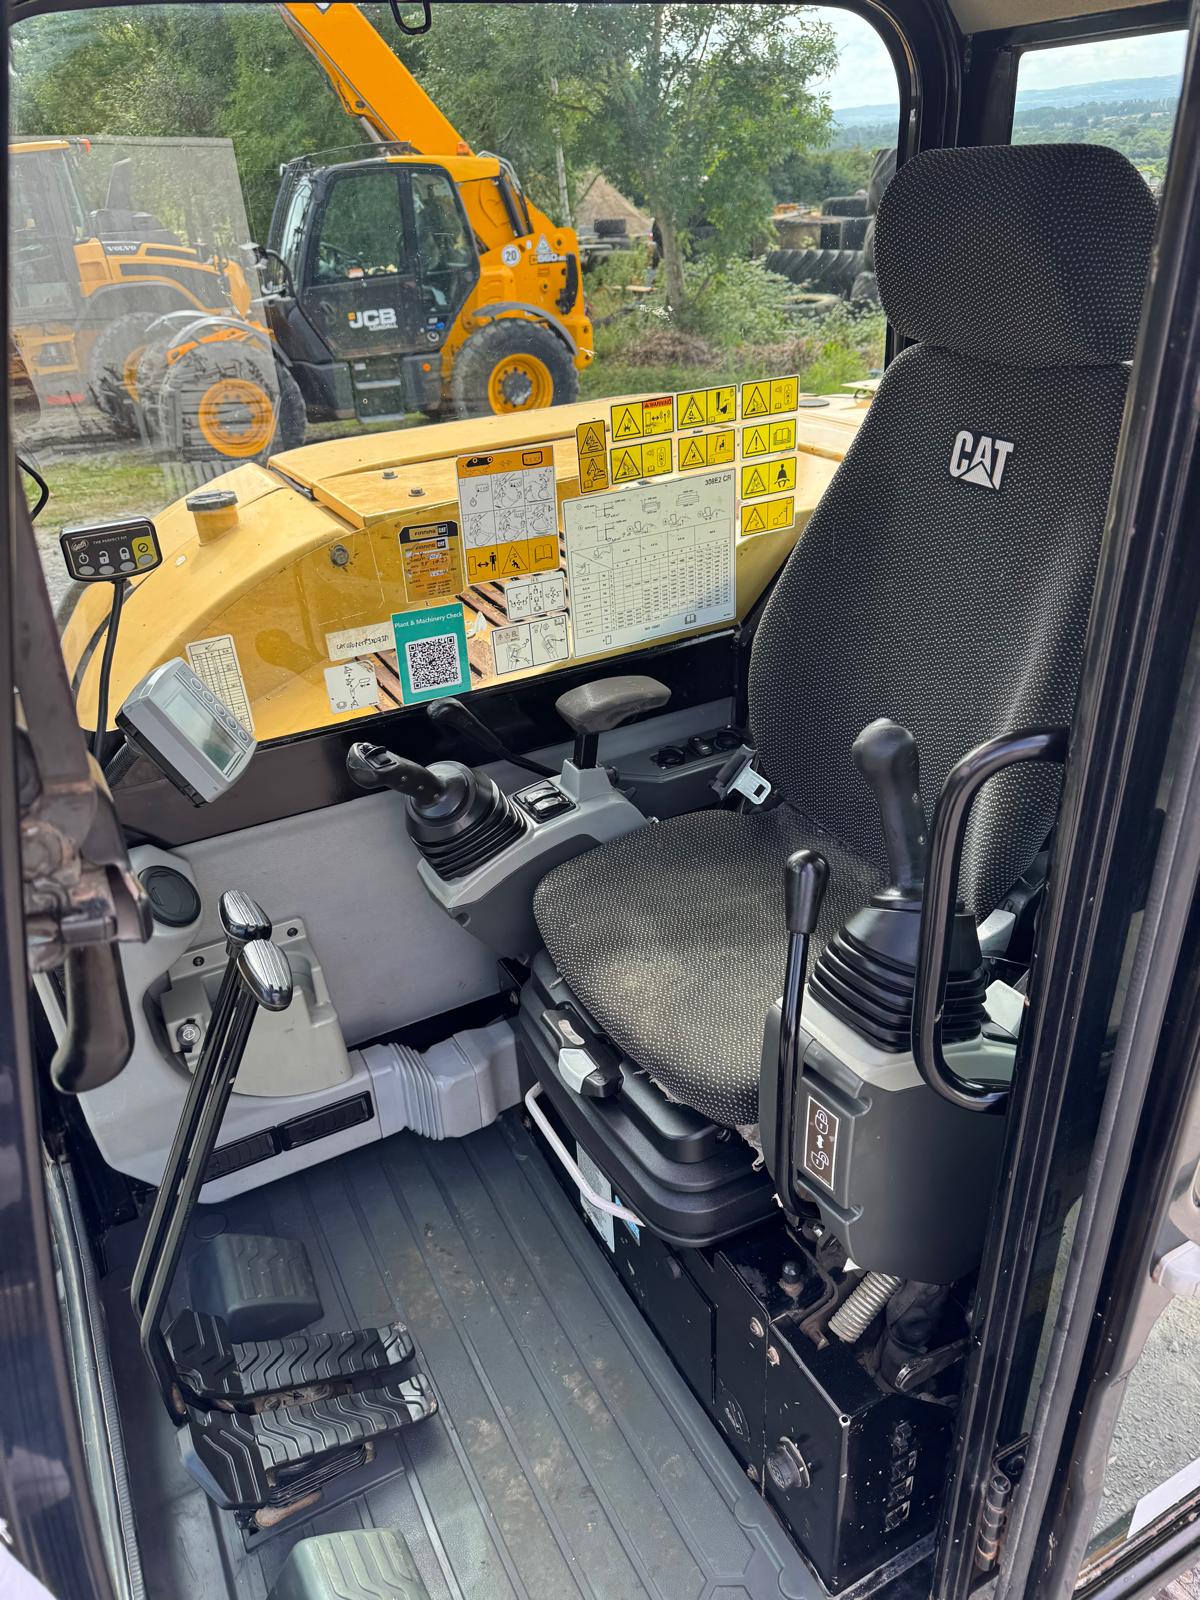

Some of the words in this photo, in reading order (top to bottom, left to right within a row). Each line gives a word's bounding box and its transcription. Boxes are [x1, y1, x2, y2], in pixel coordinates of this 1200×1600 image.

[505, 250, 517, 262] 20
[348, 308, 397, 329] JCB
[650, 399, 672, 408] WARNING
[949, 430, 1015, 490] CAT
[394, 621, 408, 629] Plant
[416, 614, 446, 625] Machinery
